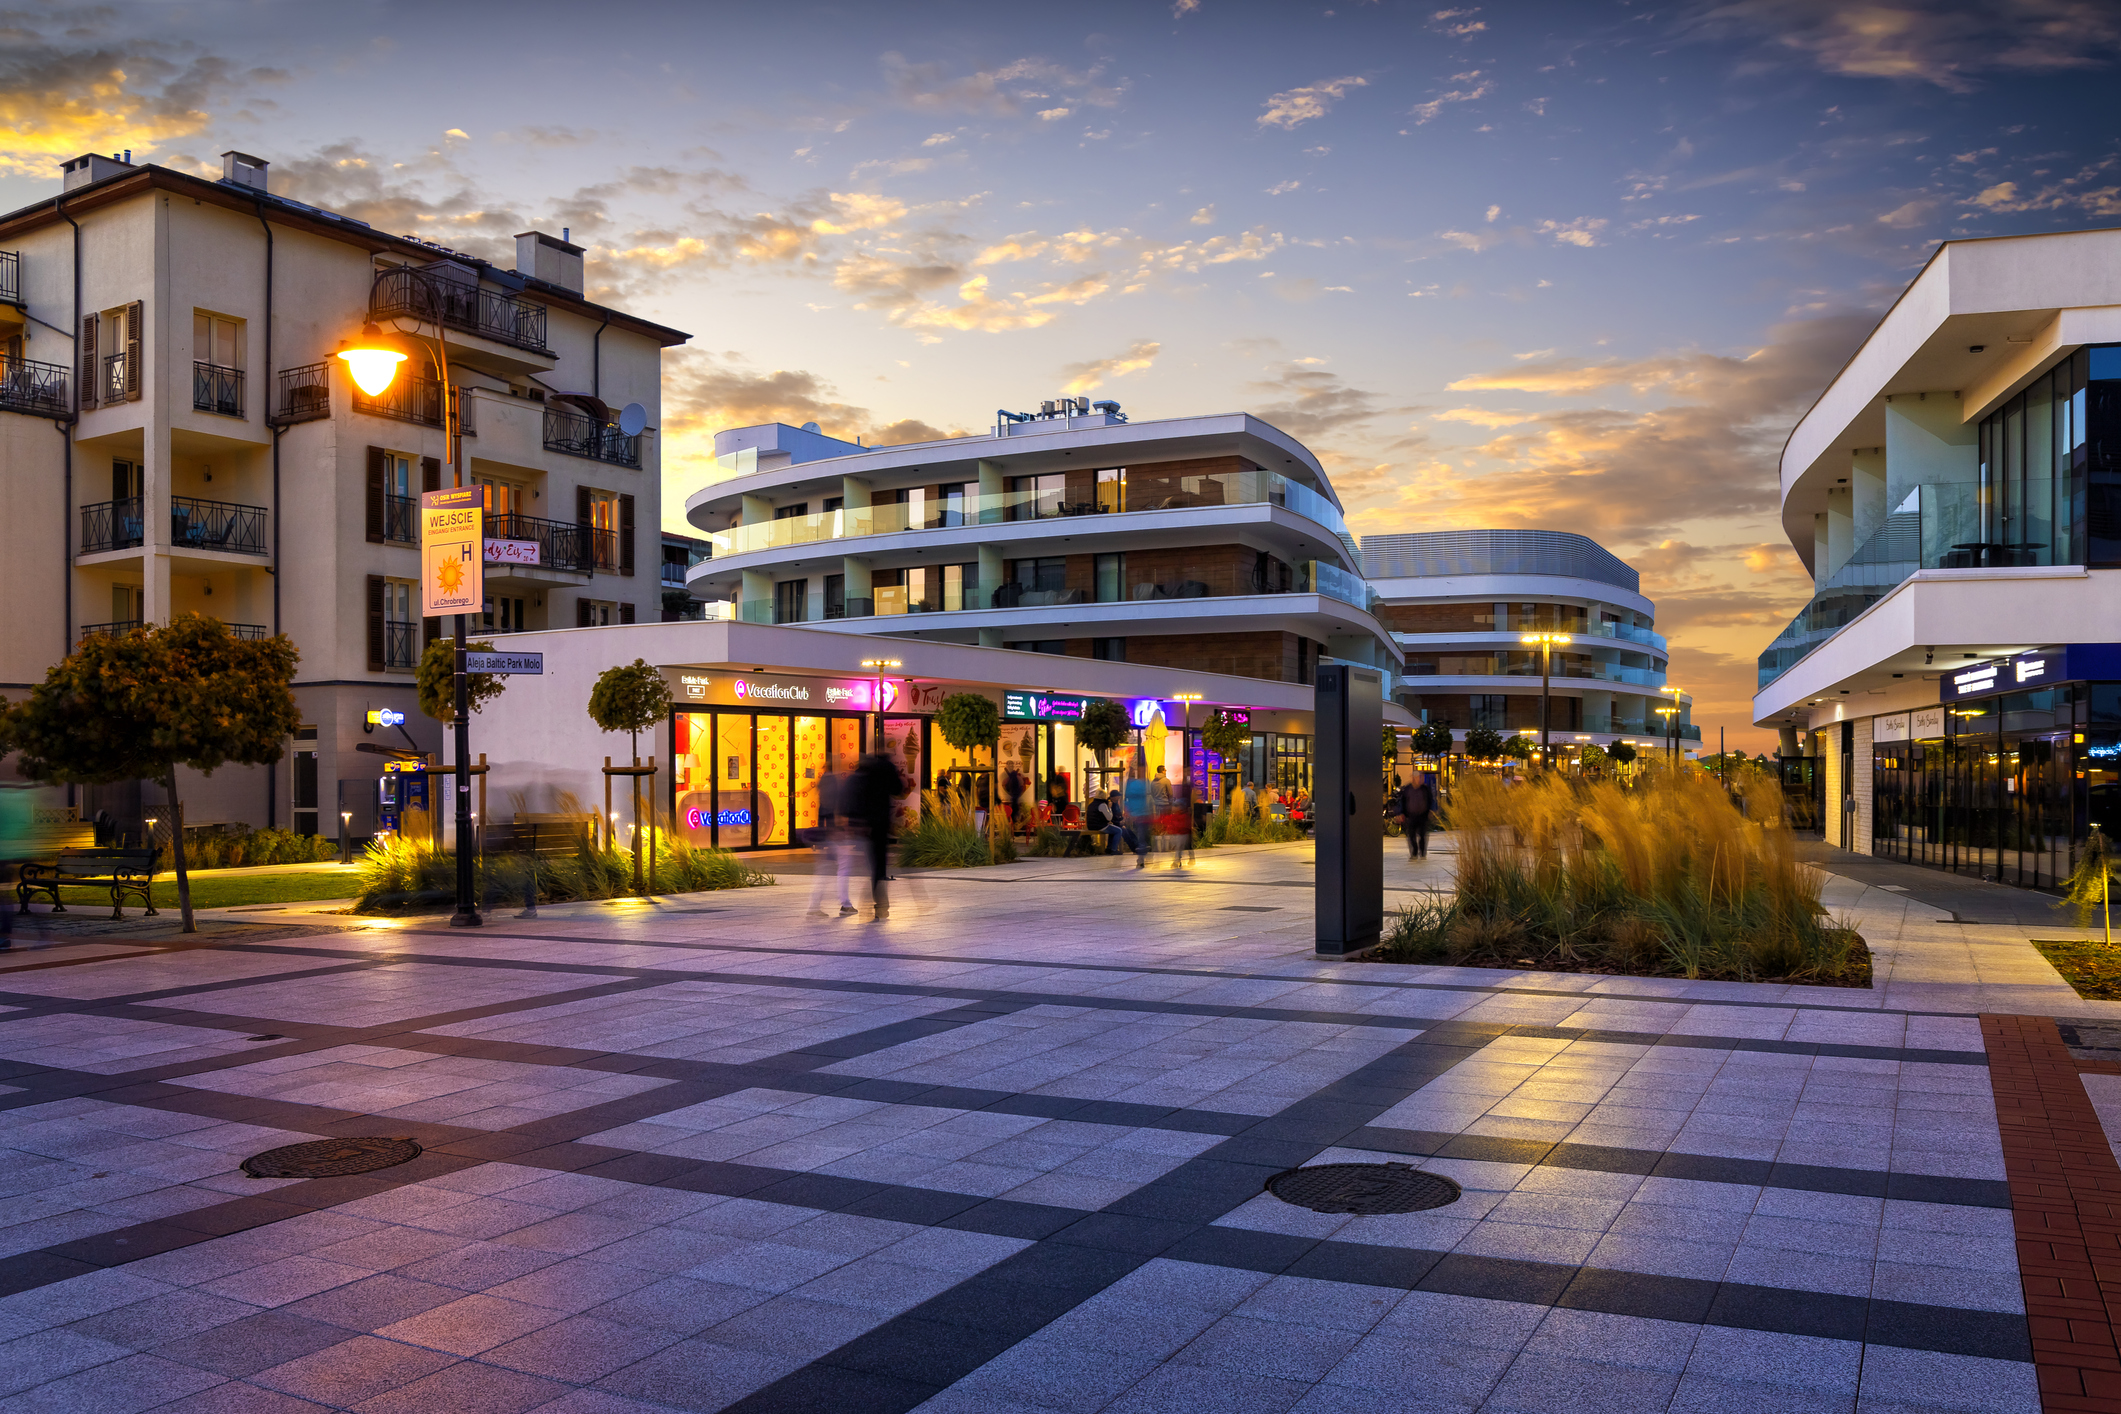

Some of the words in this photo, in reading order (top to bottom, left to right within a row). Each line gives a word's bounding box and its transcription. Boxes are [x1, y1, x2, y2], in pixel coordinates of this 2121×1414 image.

[430, 511, 473, 528] WEJŚCIE
[450, 524, 474, 532] ENTRANCE
[462, 544, 472, 562] H
[468, 657, 484, 670] Aleja
[486, 658, 506, 668] Baltic
[508, 658, 522, 668] Park
[524, 658, 540, 669] Molo
[746, 683, 810, 700] VacationClub
